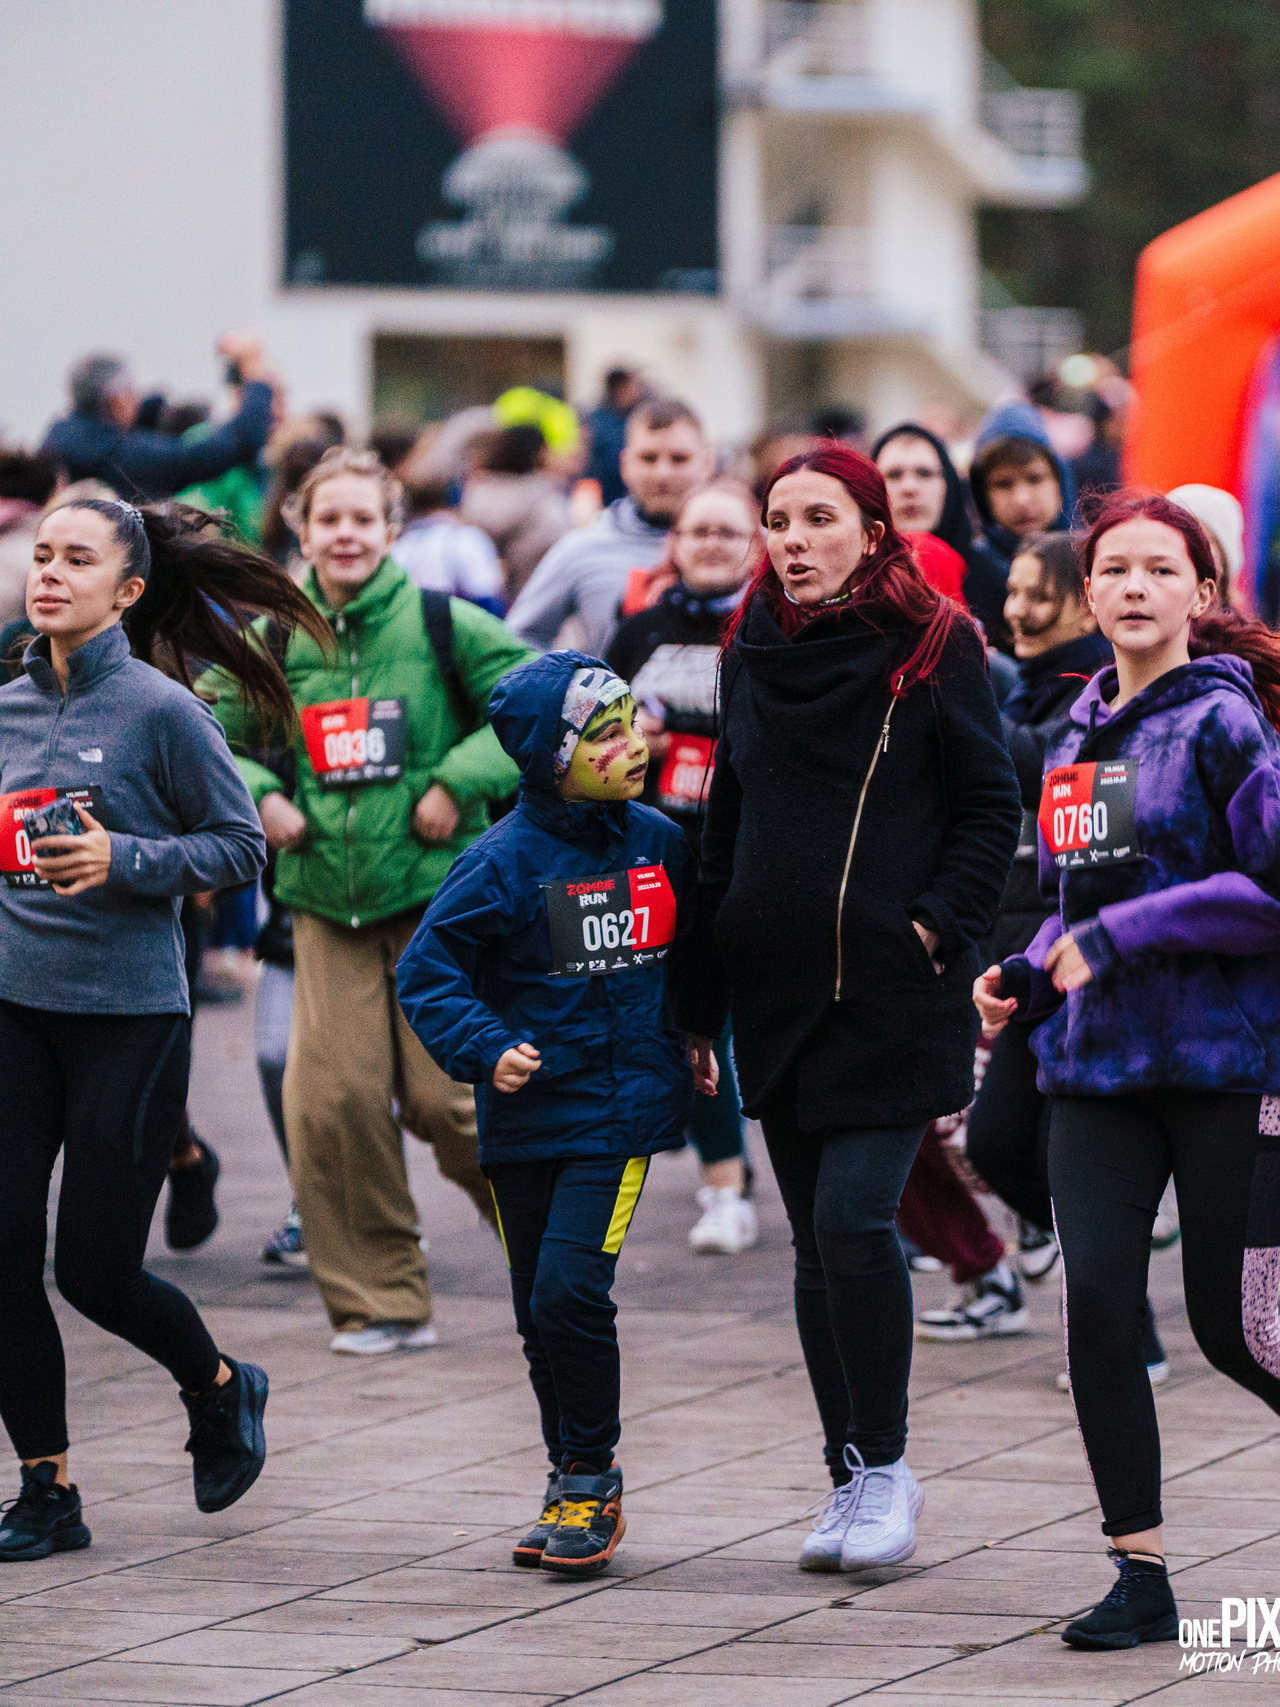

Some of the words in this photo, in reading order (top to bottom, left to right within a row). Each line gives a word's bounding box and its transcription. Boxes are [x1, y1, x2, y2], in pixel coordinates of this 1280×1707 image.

[1053, 801, 1108, 847] 0760
[566, 879, 615, 896] ZOMBIE
[579, 892, 609, 909] RUN
[582, 906, 650, 952] 0627
